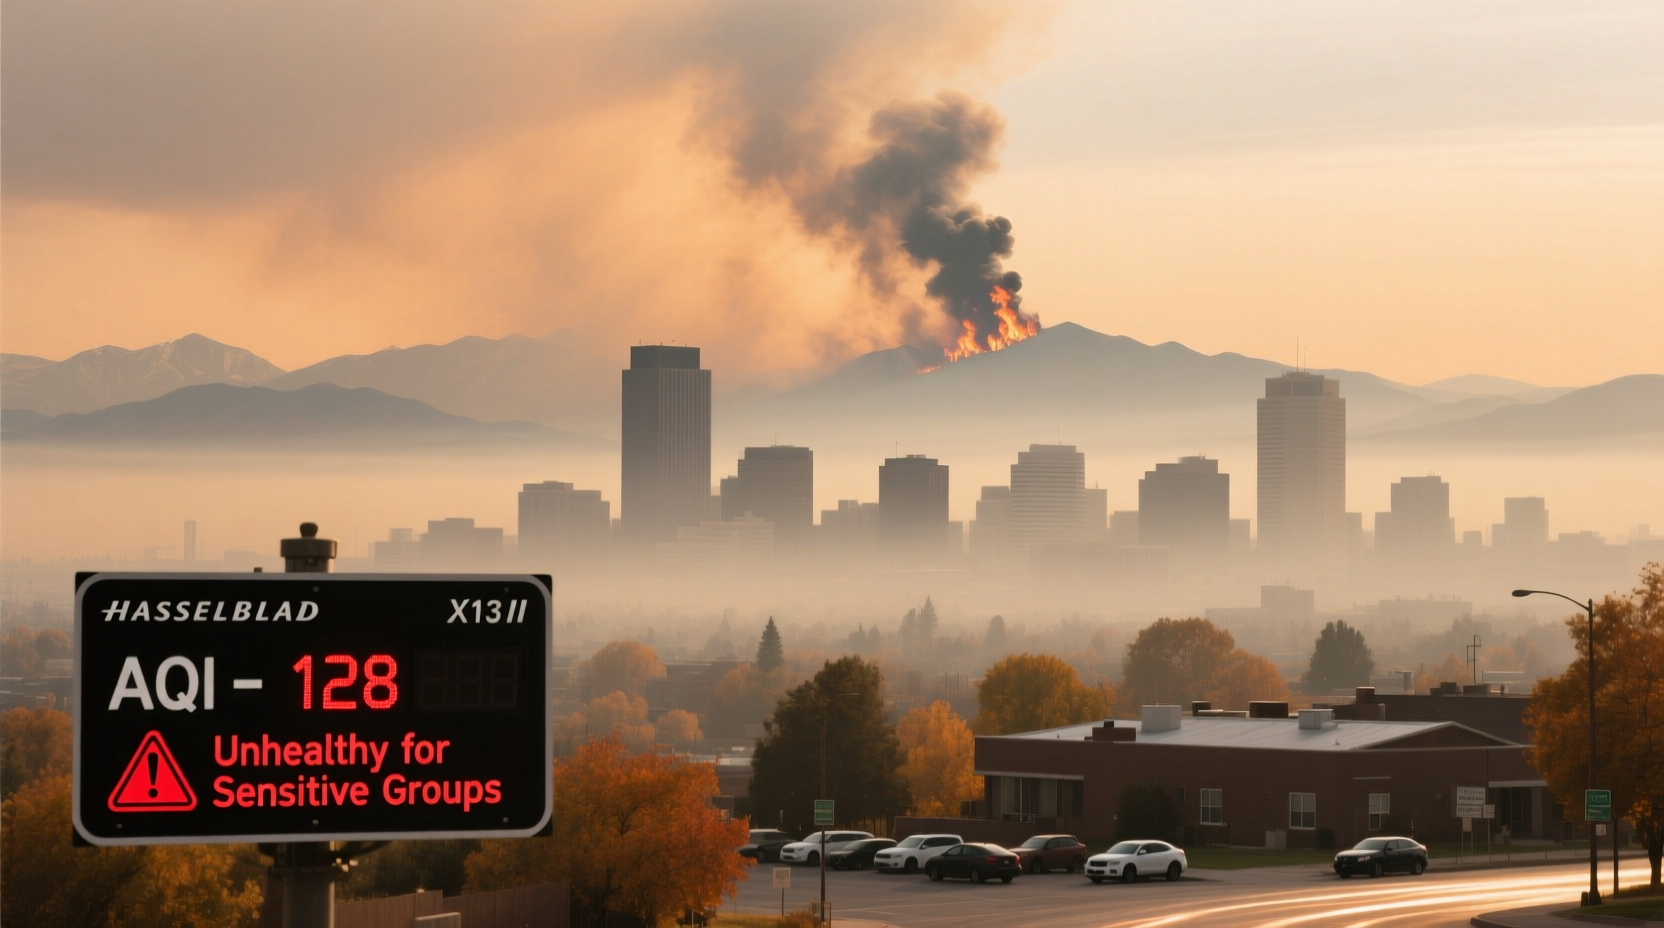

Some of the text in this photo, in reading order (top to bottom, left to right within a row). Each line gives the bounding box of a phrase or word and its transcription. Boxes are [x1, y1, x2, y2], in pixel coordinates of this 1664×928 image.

[102, 600, 319, 622] HASSELBLAD
[109, 656, 215, 713] AQI
[292, 654, 398, 710] 128
[214, 732, 450, 773] Unhealthy for
[213, 775, 502, 812] Sensitive Groups
